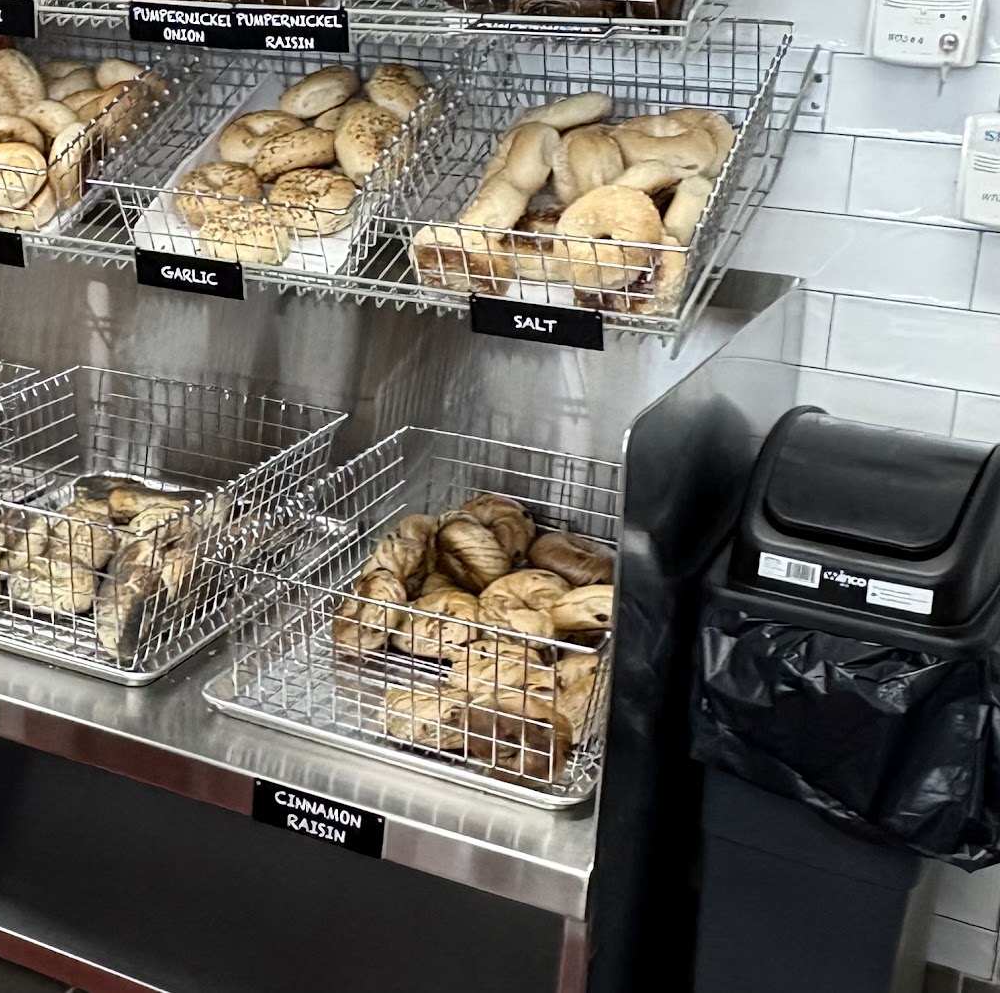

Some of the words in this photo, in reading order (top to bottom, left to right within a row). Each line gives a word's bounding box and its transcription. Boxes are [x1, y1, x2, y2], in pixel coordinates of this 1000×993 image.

[235, 13, 343, 28] PUMPERNICKEL
[163, 27, 205, 43] ONION
[265, 35, 315, 49] RAISIN
[160, 266, 218, 286] GARLIC
[513, 315, 557, 333] SALT
[274, 791, 362, 829] CINNAMON
[287, 813, 346, 844] RAISIN
